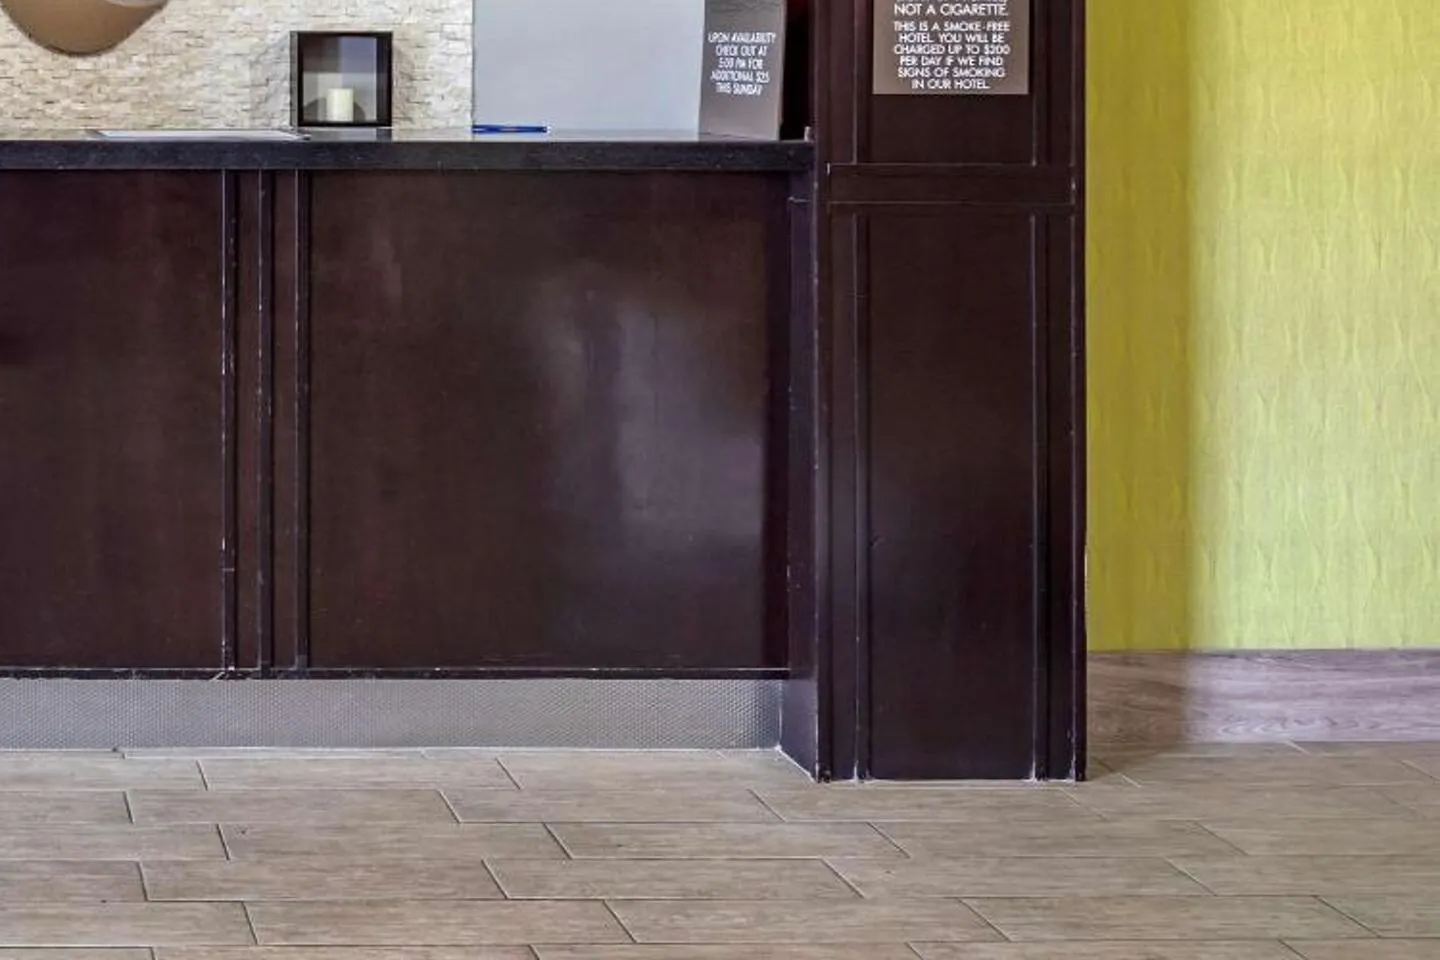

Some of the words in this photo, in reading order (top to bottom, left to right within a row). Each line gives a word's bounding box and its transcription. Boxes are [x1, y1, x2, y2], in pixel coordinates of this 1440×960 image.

[894, 3, 922, 16] NOT
[926, 3, 936, 16] A
[894, 21, 916, 31] THIS
[919, 21, 928, 31] IS
[931, 21, 940, 31] A
[939, 32, 961, 43] YOU
[965, 32, 988, 43] WILL
[992, 32, 1005, 43] BE
[894, 44, 945, 55] CHARGED
[948, 44, 962, 55] UP
[965, 44, 980, 55] TO
[900, 55, 917, 66] PER
[921, 55, 942, 66] DAY
[945, 55, 954, 66] IF
[957, 55, 975, 66] WE
[979, 55, 1003, 66] FIND
[898, 67, 931, 78] SIGNS
[933, 67, 949, 78] OF
[952, 67, 1005, 78] SMOKING
[911, 78, 924, 89] IN
[927, 78, 951, 89] OUR
